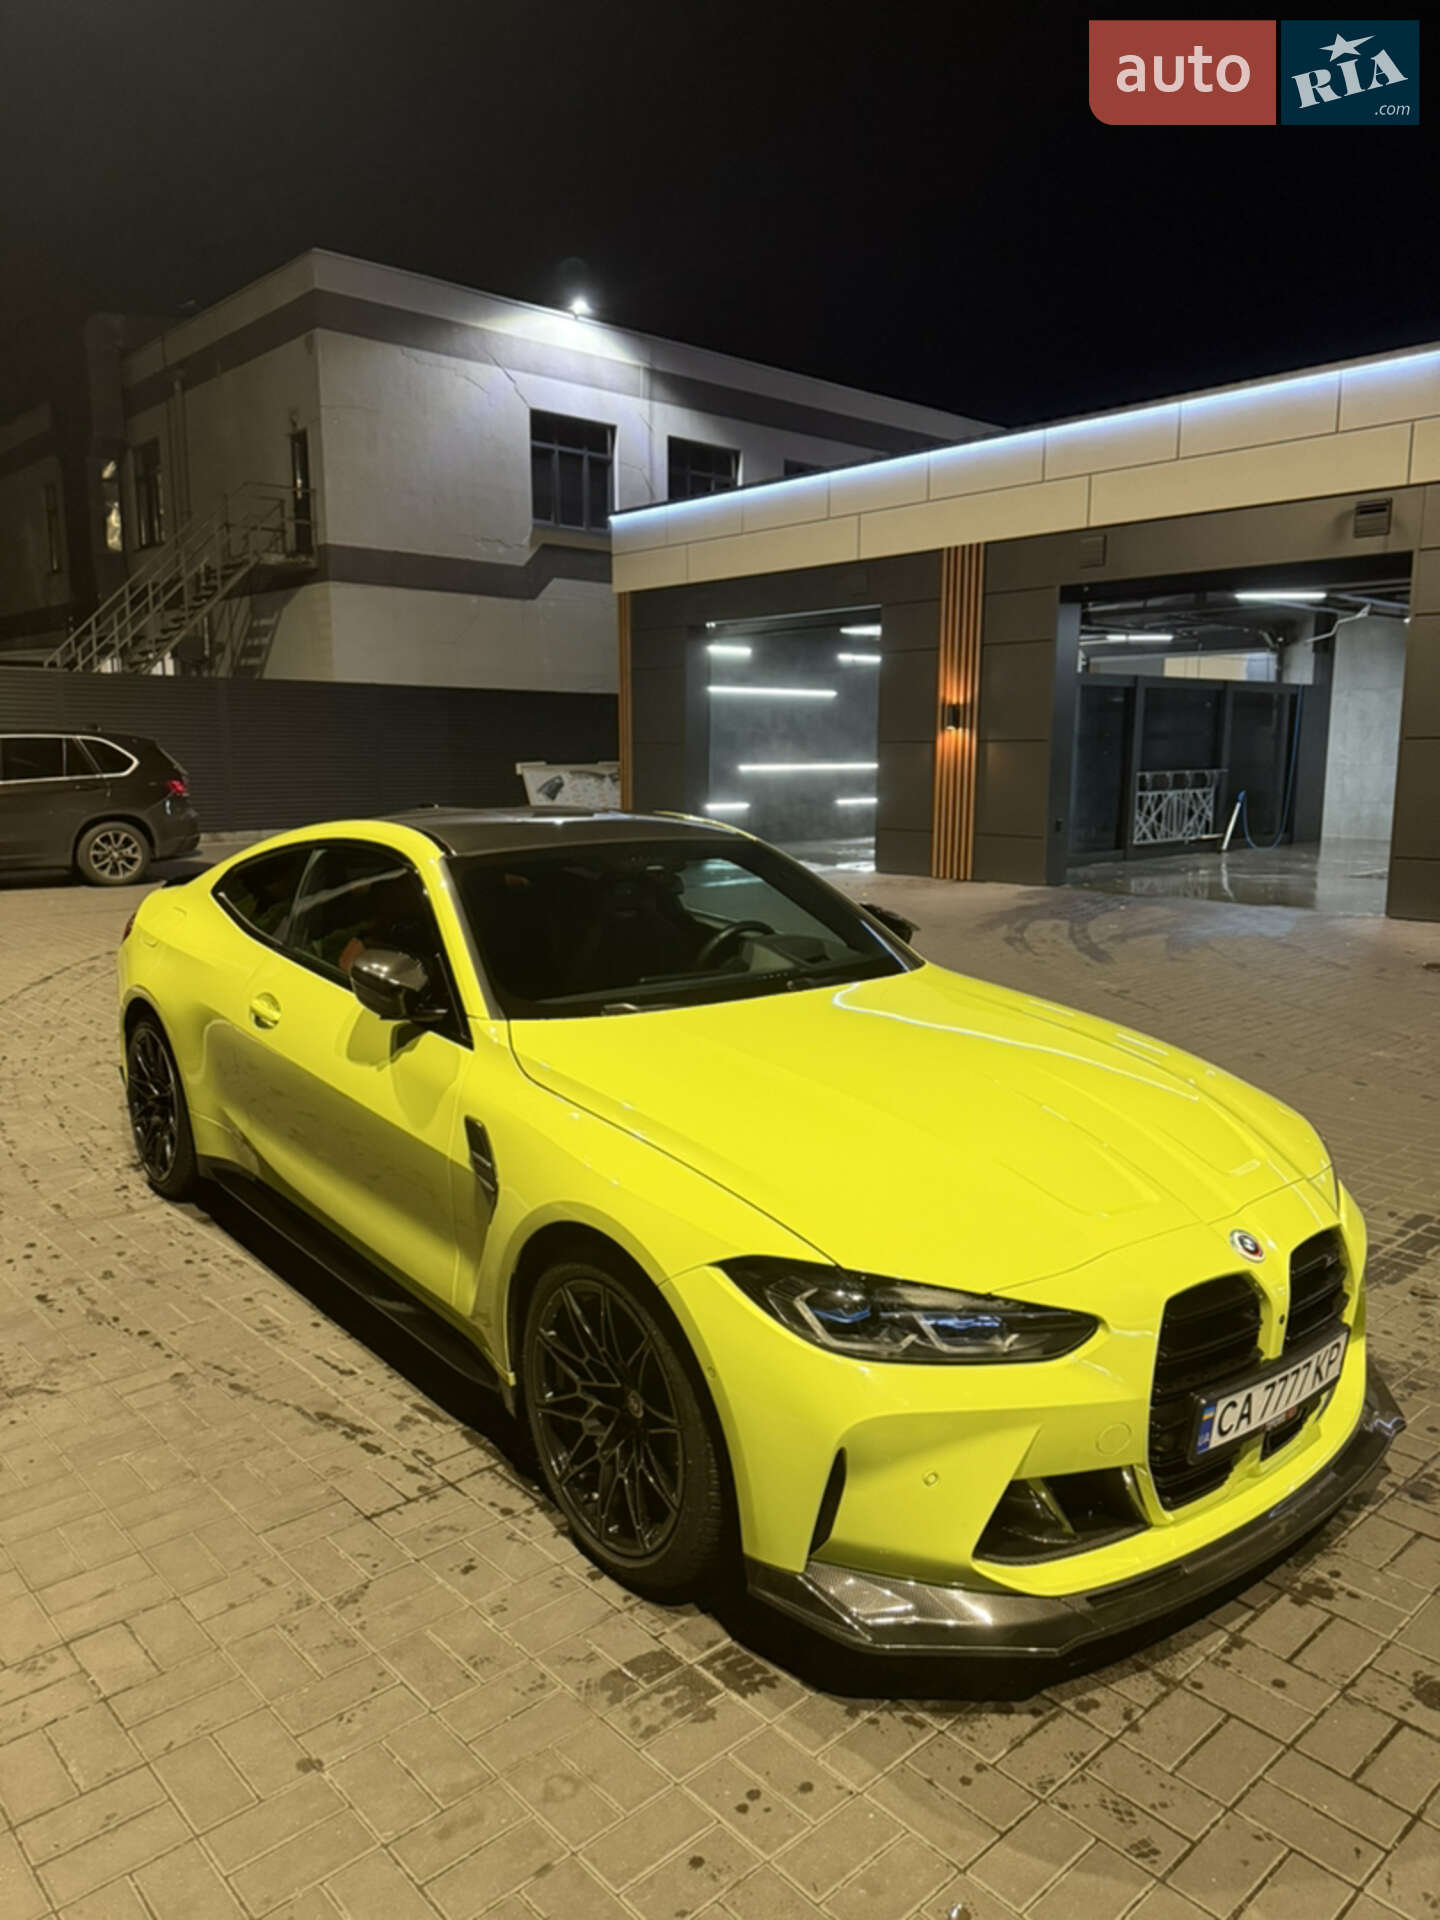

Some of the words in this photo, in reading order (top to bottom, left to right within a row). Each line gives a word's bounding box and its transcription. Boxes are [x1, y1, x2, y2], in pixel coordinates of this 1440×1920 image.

[1217, 1392, 1252, 1437] CA
[1259, 1360, 1312, 1421] 7777
[1311, 1341, 1342, 1389] KP
